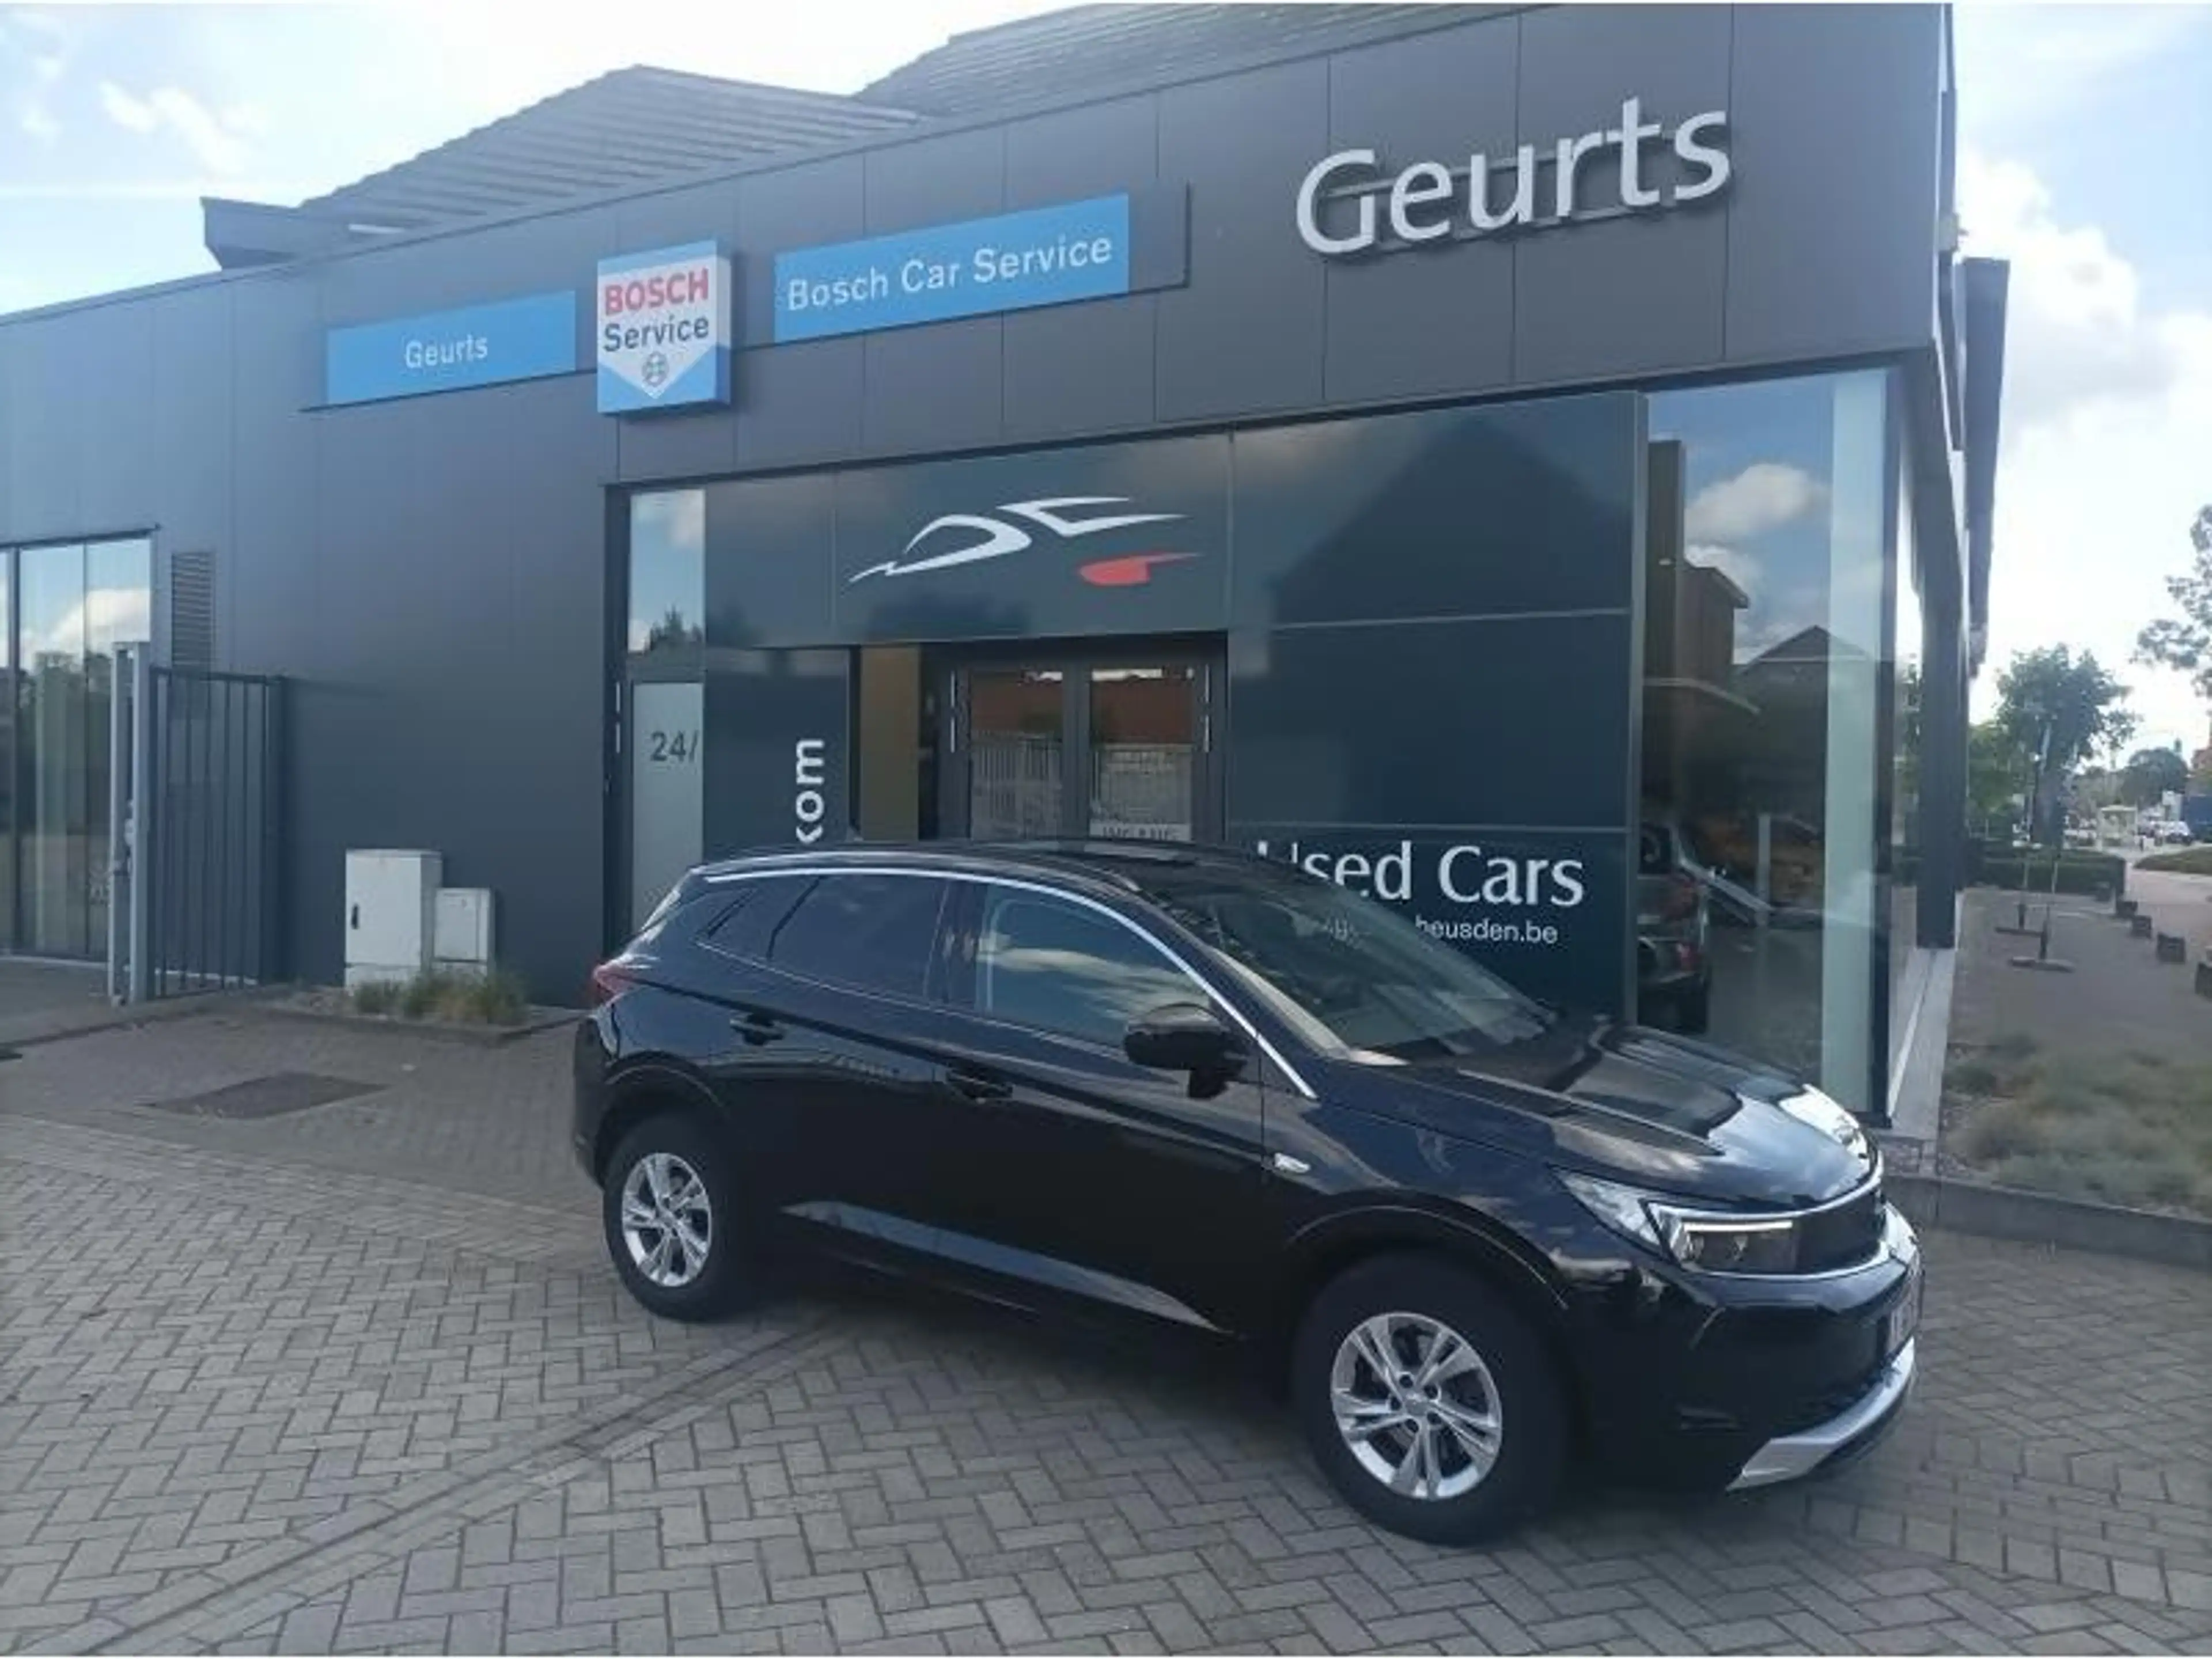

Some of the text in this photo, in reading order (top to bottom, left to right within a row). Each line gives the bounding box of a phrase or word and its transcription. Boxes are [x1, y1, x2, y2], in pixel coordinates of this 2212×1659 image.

[1296, 96, 1730, 255] Geurts
[604, 267, 709, 317] BOSCH
[787, 233, 1112, 311] Bosch Car Service
[404, 334, 488, 369] Geurts
[604, 313, 709, 353] Service
[1257, 839, 1585, 907] sed Cars
